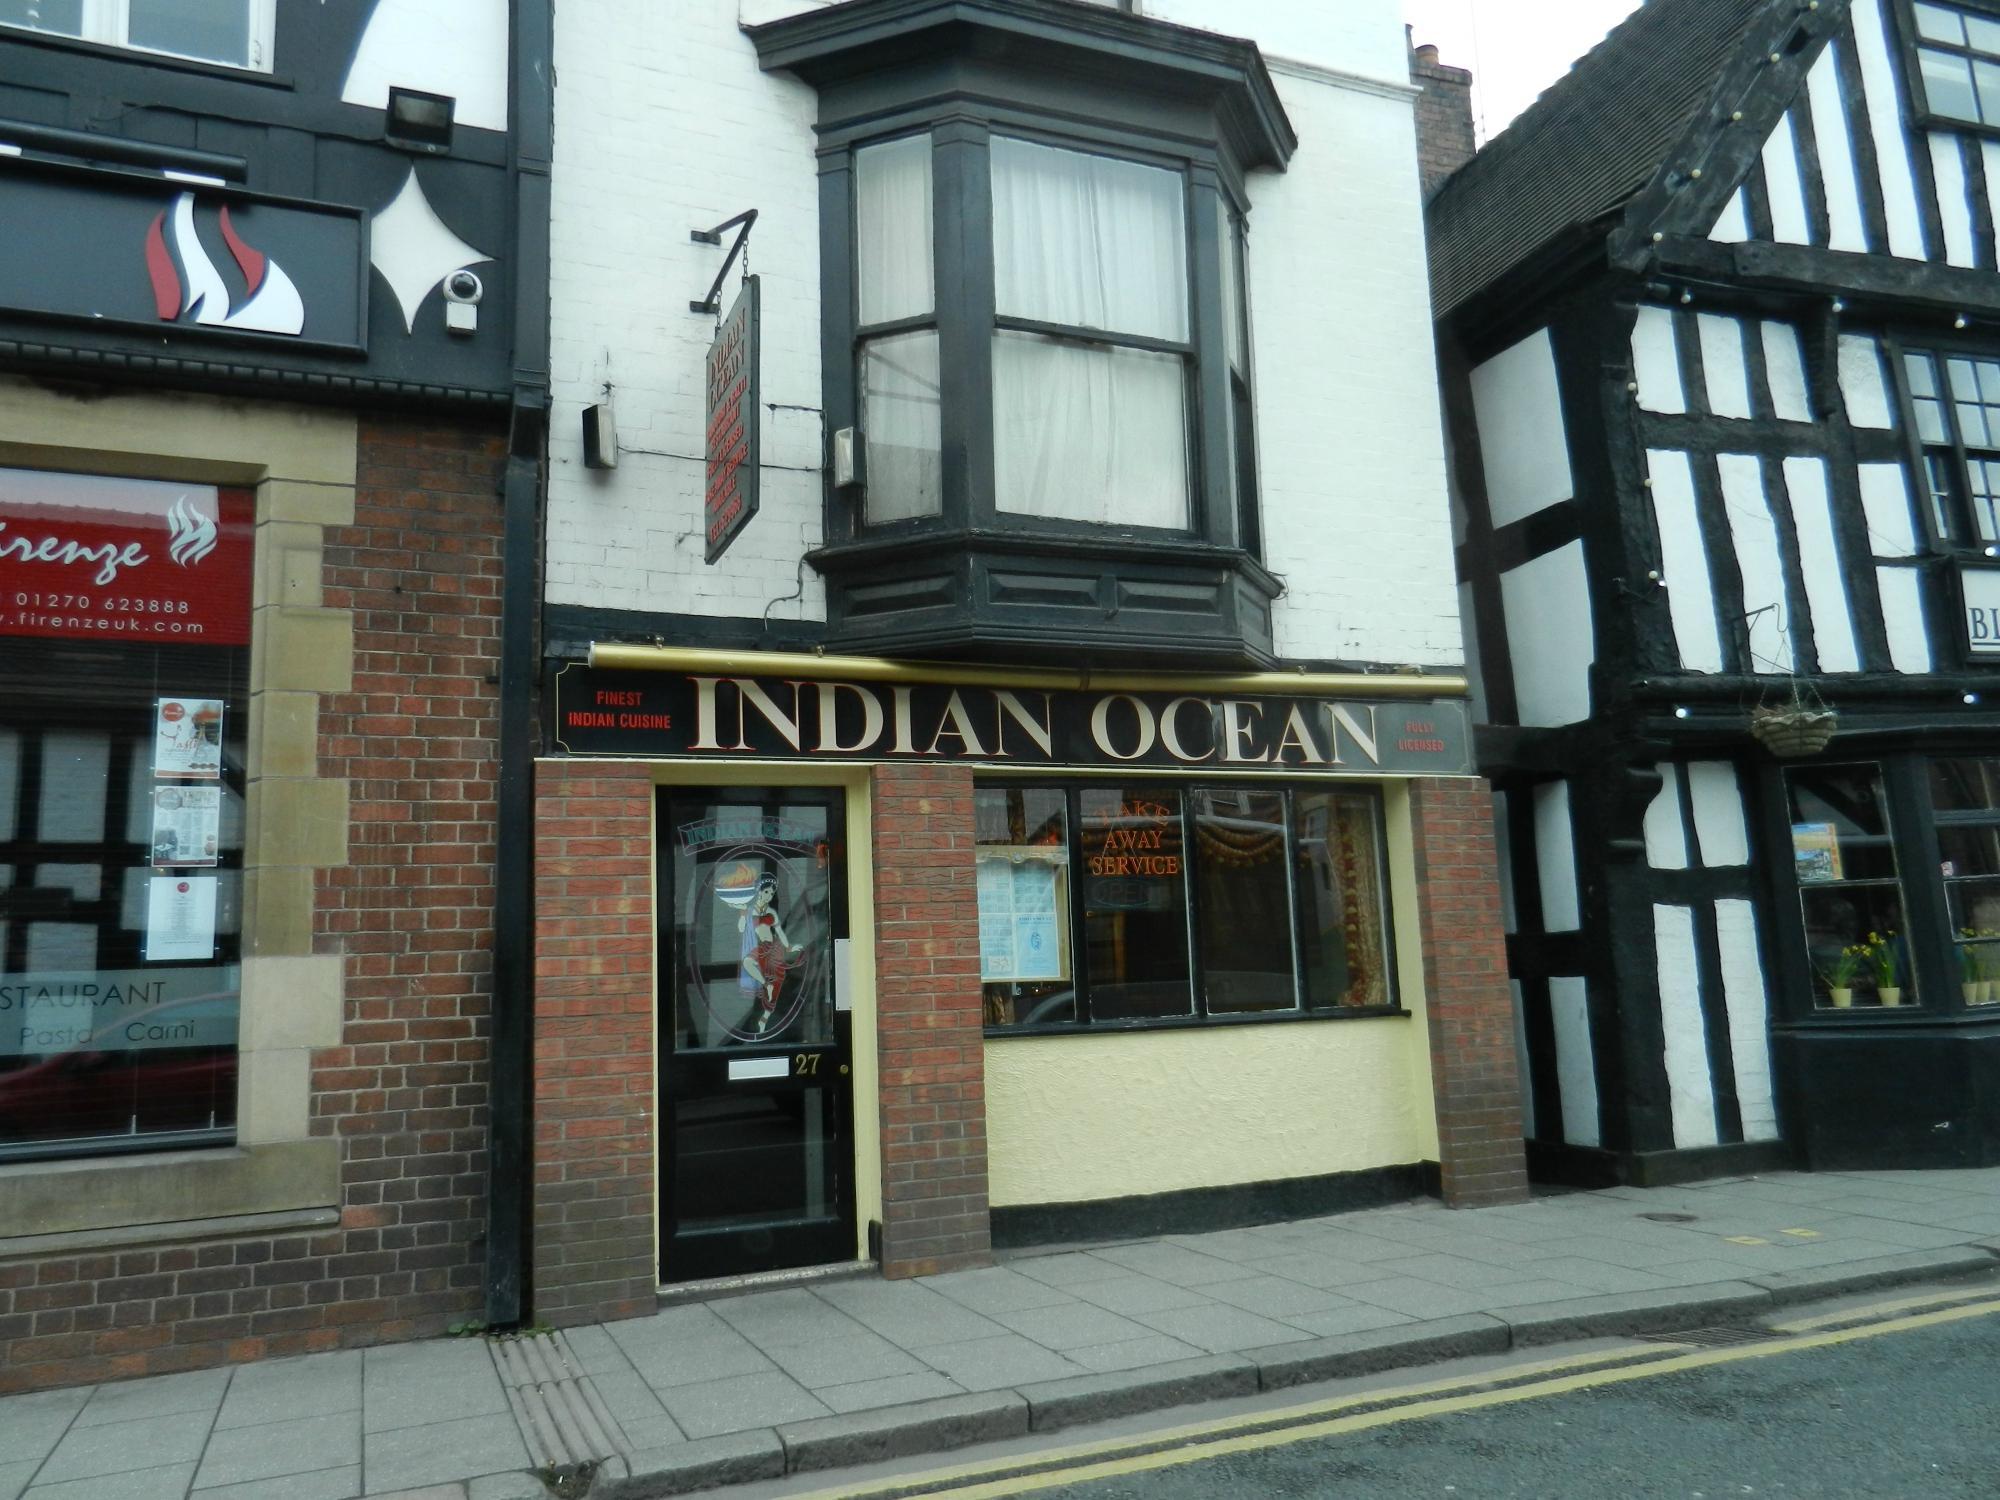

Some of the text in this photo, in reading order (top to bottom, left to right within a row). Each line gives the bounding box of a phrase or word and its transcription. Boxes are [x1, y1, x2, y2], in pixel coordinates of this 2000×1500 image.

[709, 307, 746, 389] INDIAN
[710, 339, 745, 413] OCEAN
[16, 592, 189, 615] 01270 623888
[596, 690, 642, 706] FINEST
[568, 711, 671, 729] INDIAN CUISINE
[686, 676, 1380, 766] INDIAN OCEAN
[1104, 830, 1164, 849] AWAY
[1092, 856, 1179, 876] SERVICE
[0, 981, 167, 1010] STAURANT
[20, 1019, 196, 1046] Pasta Carni
[796, 1053, 822, 1075] 27
